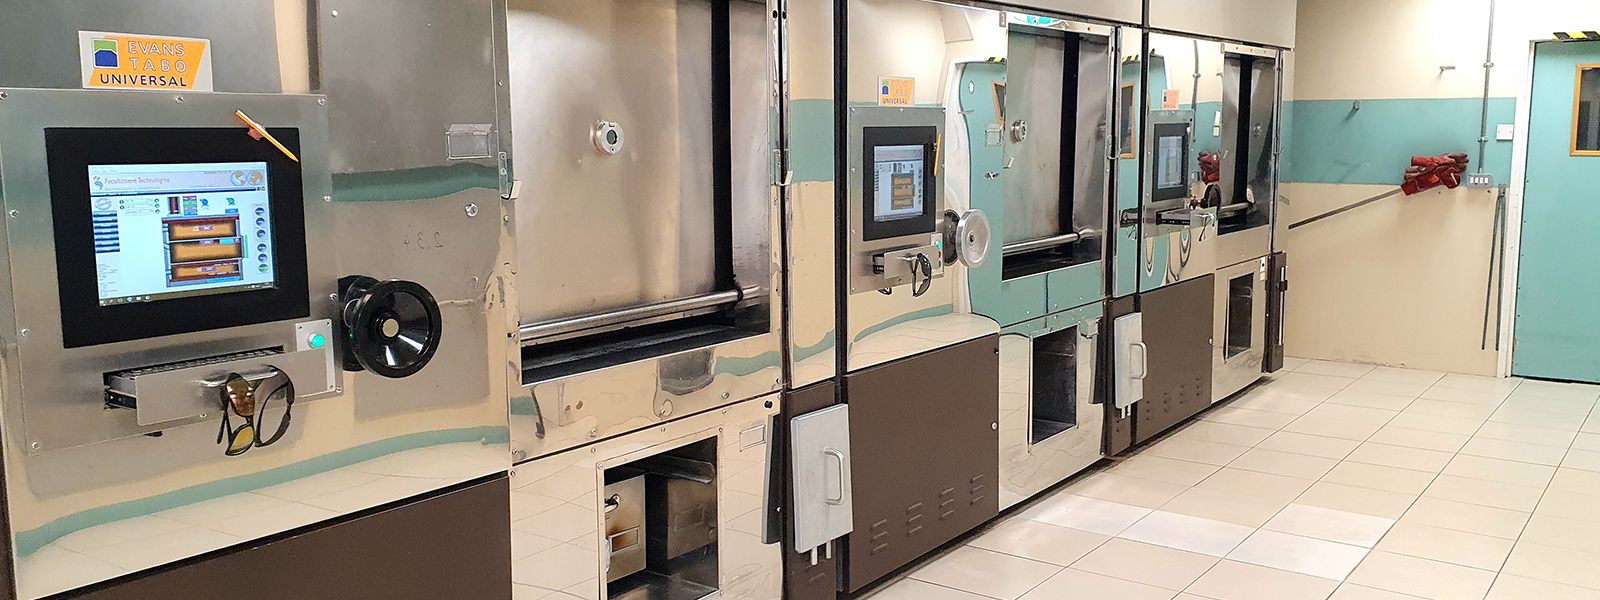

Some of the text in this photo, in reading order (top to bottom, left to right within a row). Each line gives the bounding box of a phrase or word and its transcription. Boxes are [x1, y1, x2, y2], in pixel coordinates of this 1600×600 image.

[128, 41, 185, 57] EVANS
[130, 58, 186, 73] TABO
[100, 73, 187, 87] UNIVERSAL
